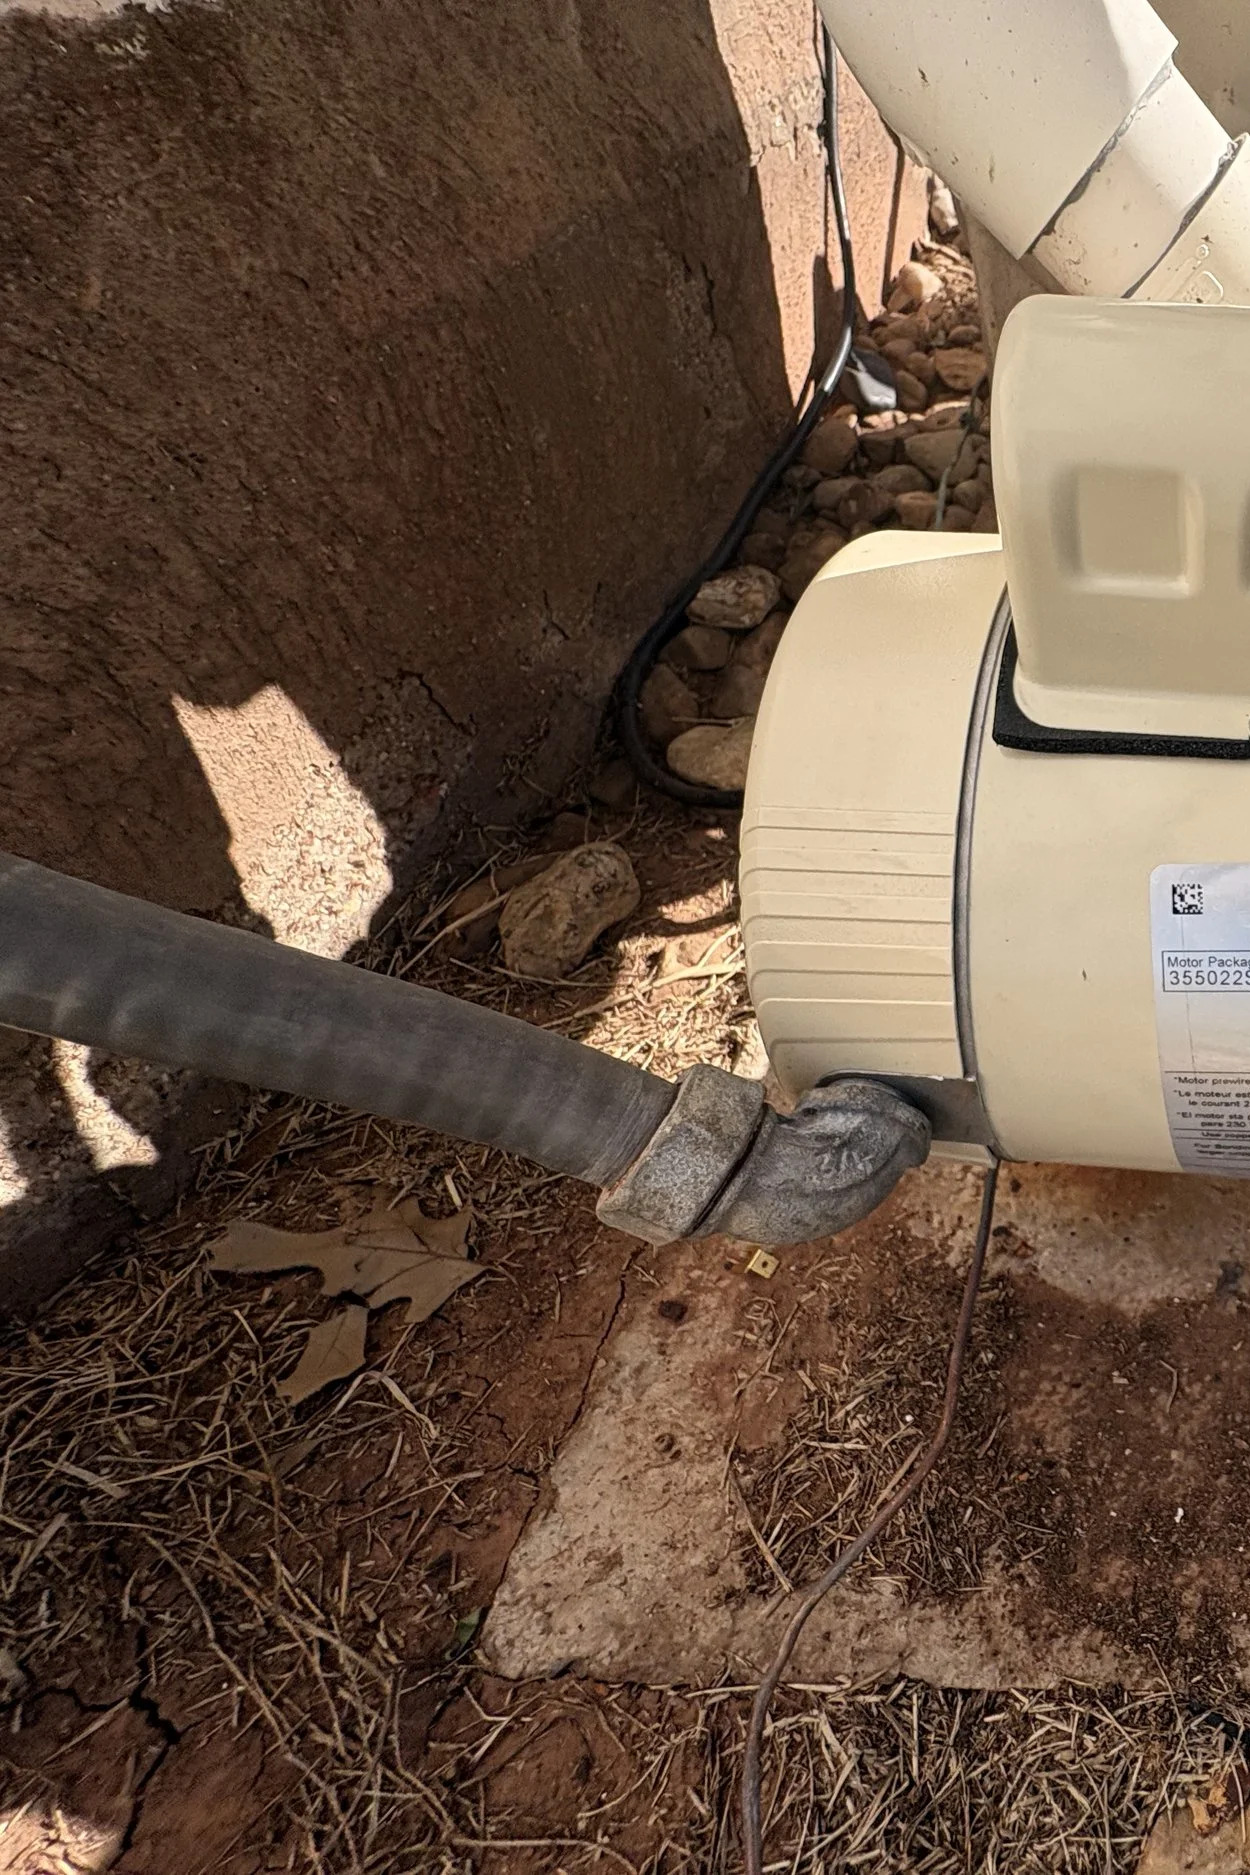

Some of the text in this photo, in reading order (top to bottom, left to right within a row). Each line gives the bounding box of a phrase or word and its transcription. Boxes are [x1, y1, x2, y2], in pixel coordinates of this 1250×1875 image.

[1167, 956, 1203, 968] Motor
[1195, 1090, 1231, 1098] moteur
[1195, 1112, 1225, 1120] motor
